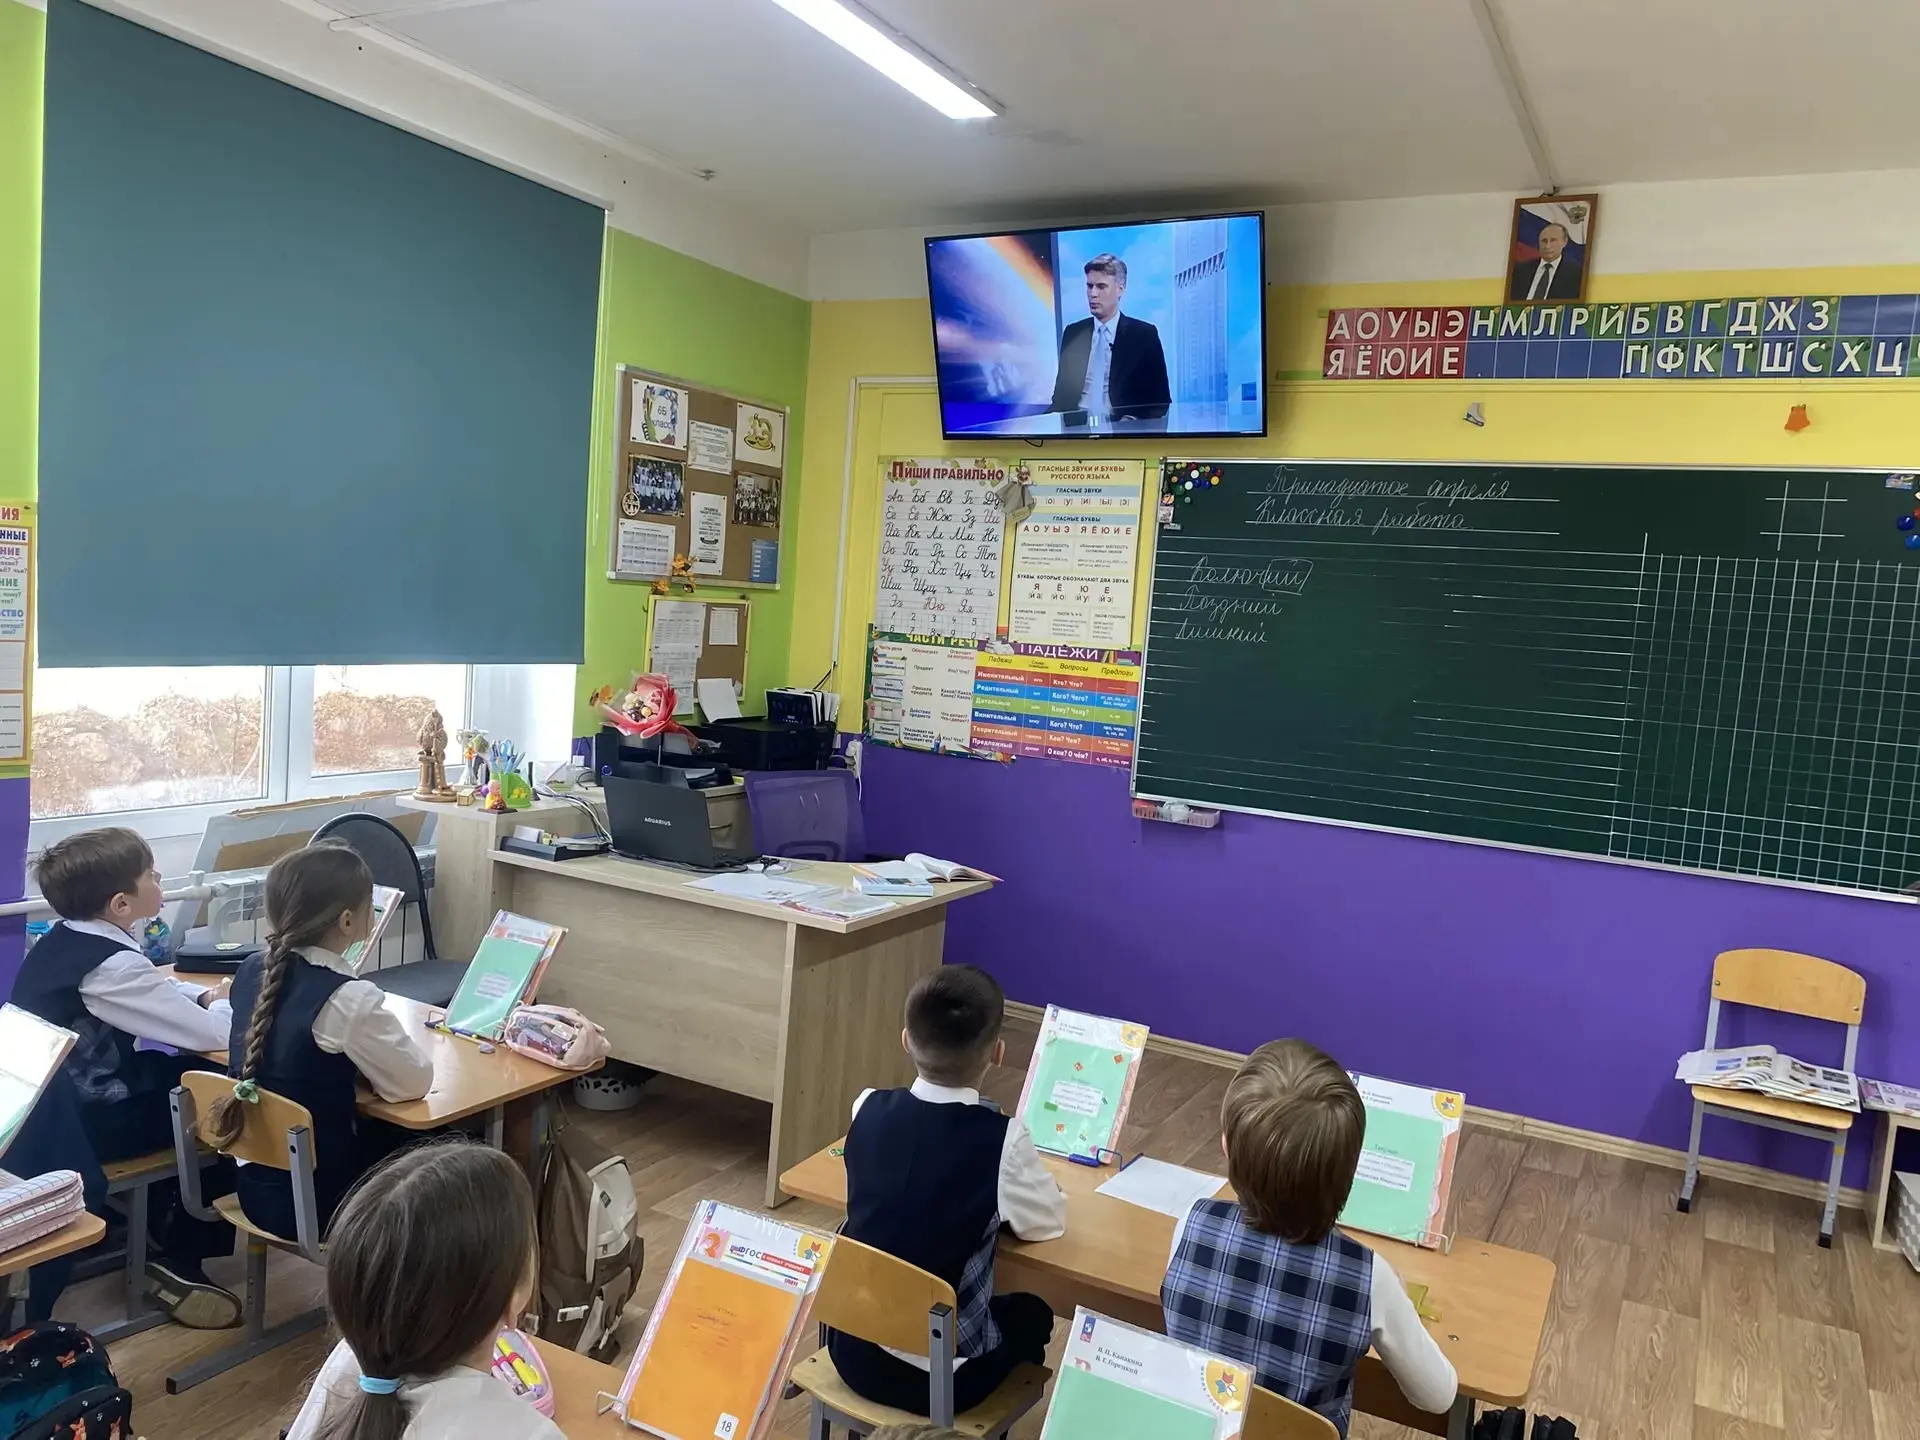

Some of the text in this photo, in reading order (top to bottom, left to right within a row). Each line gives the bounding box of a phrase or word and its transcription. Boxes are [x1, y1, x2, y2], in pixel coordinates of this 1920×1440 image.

[1256, 495, 1363, 525] Классная
[911, 613, 915, 621] 2
[931, 614, 936, 622] 3
[972, 618, 977, 626] 5
[1021, 644, 1098, 659] ПАДЕЖИ
[988, 656, 1012, 664] Падежи
[1060, 663, 1088, 672] Вопросы
[1101, 668, 1133, 677] Предлоги
[978, 671, 1024, 681] Именительный
[977, 684, 1019, 694] Родительный
[1052, 692, 1088, 702] Кого? Чего?
[976, 698, 1011, 707] Дательный
[975, 711, 1016, 721] Винительный
[1050, 721, 1083, 730] Кого? Что?
[973, 726, 1018, 736] Творительный
[972, 738, 1012, 748] Предложный
[722, 1420, 732, 1432] 18
